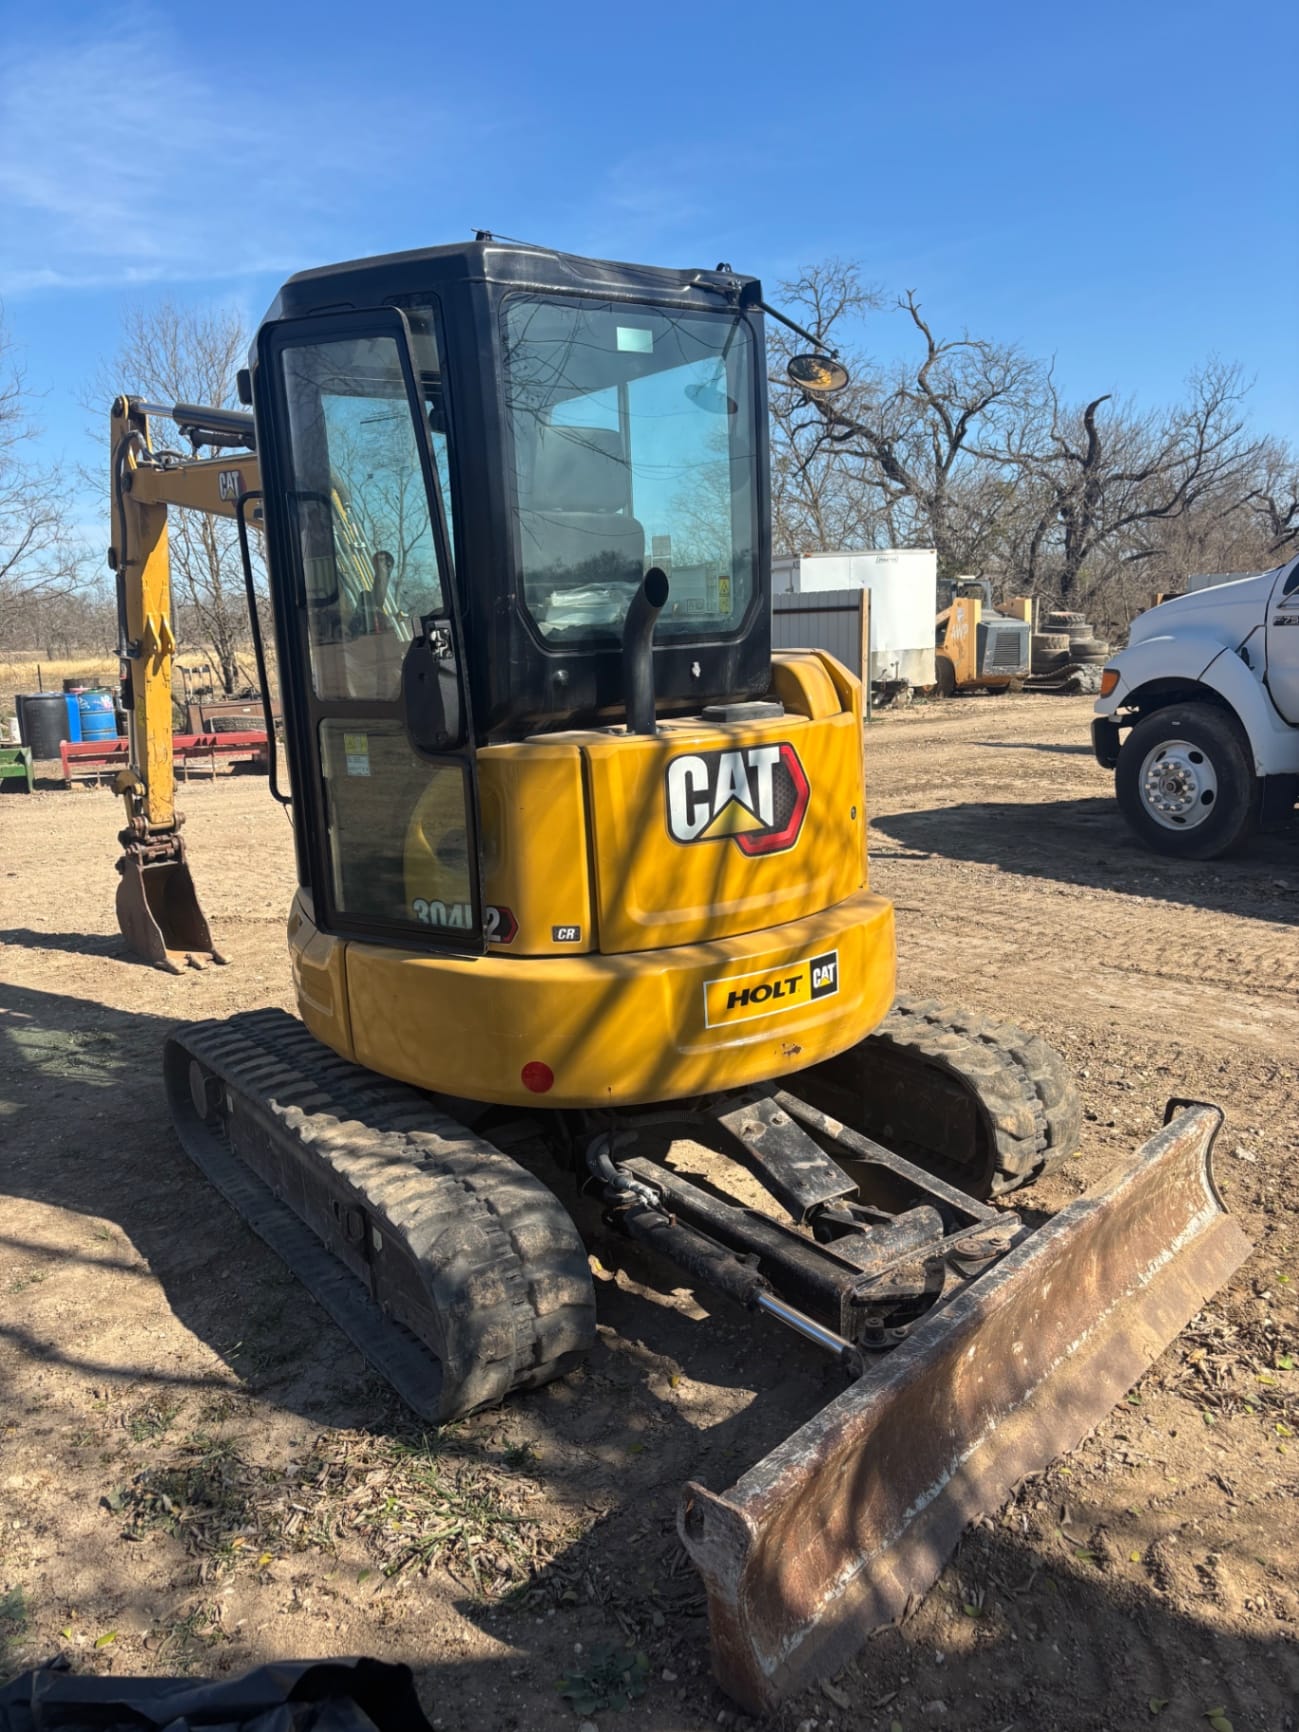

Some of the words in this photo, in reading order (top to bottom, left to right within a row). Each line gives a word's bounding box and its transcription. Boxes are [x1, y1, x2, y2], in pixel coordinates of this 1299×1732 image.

[219, 471, 240, 500] CAT
[668, 746, 780, 841] CAT
[558, 928, 576, 940] CR
[726, 975, 803, 1010] HOLT
[812, 962, 837, 989] CAT
